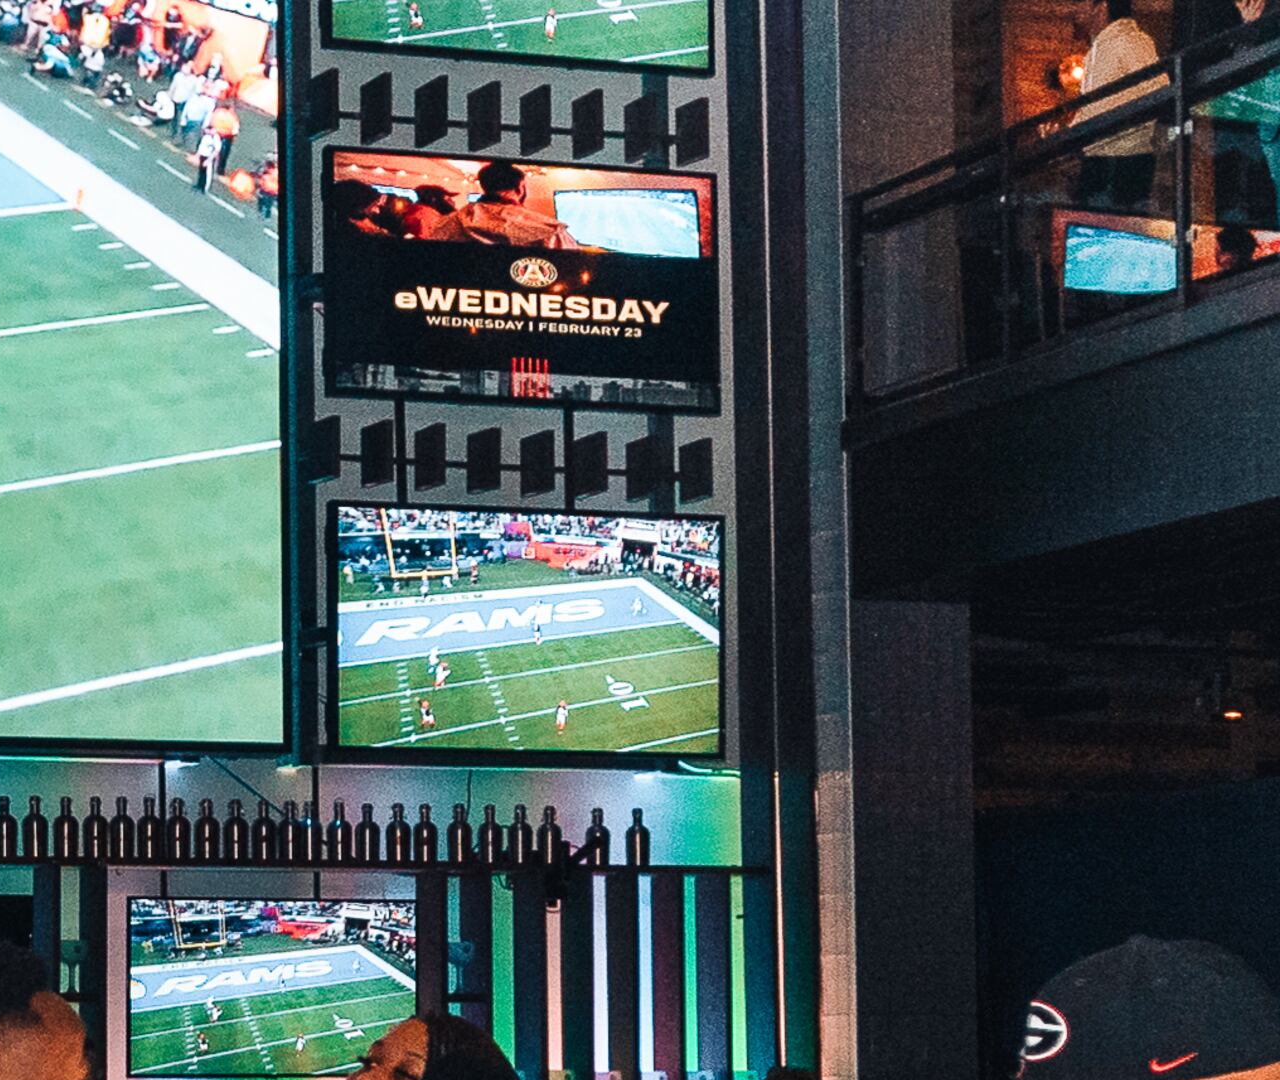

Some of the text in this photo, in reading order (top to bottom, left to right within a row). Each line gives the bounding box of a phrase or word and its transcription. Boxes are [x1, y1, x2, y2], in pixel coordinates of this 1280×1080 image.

[394, 285, 670, 325] eWEDNESDAY
[426, 315, 525, 332] WEDNESDAY
[538, 321, 621, 337] FEBRUARY
[624, 326, 642, 338] 23
[354, 598, 606, 647] RAMS
[153, 959, 334, 997] RAMS
